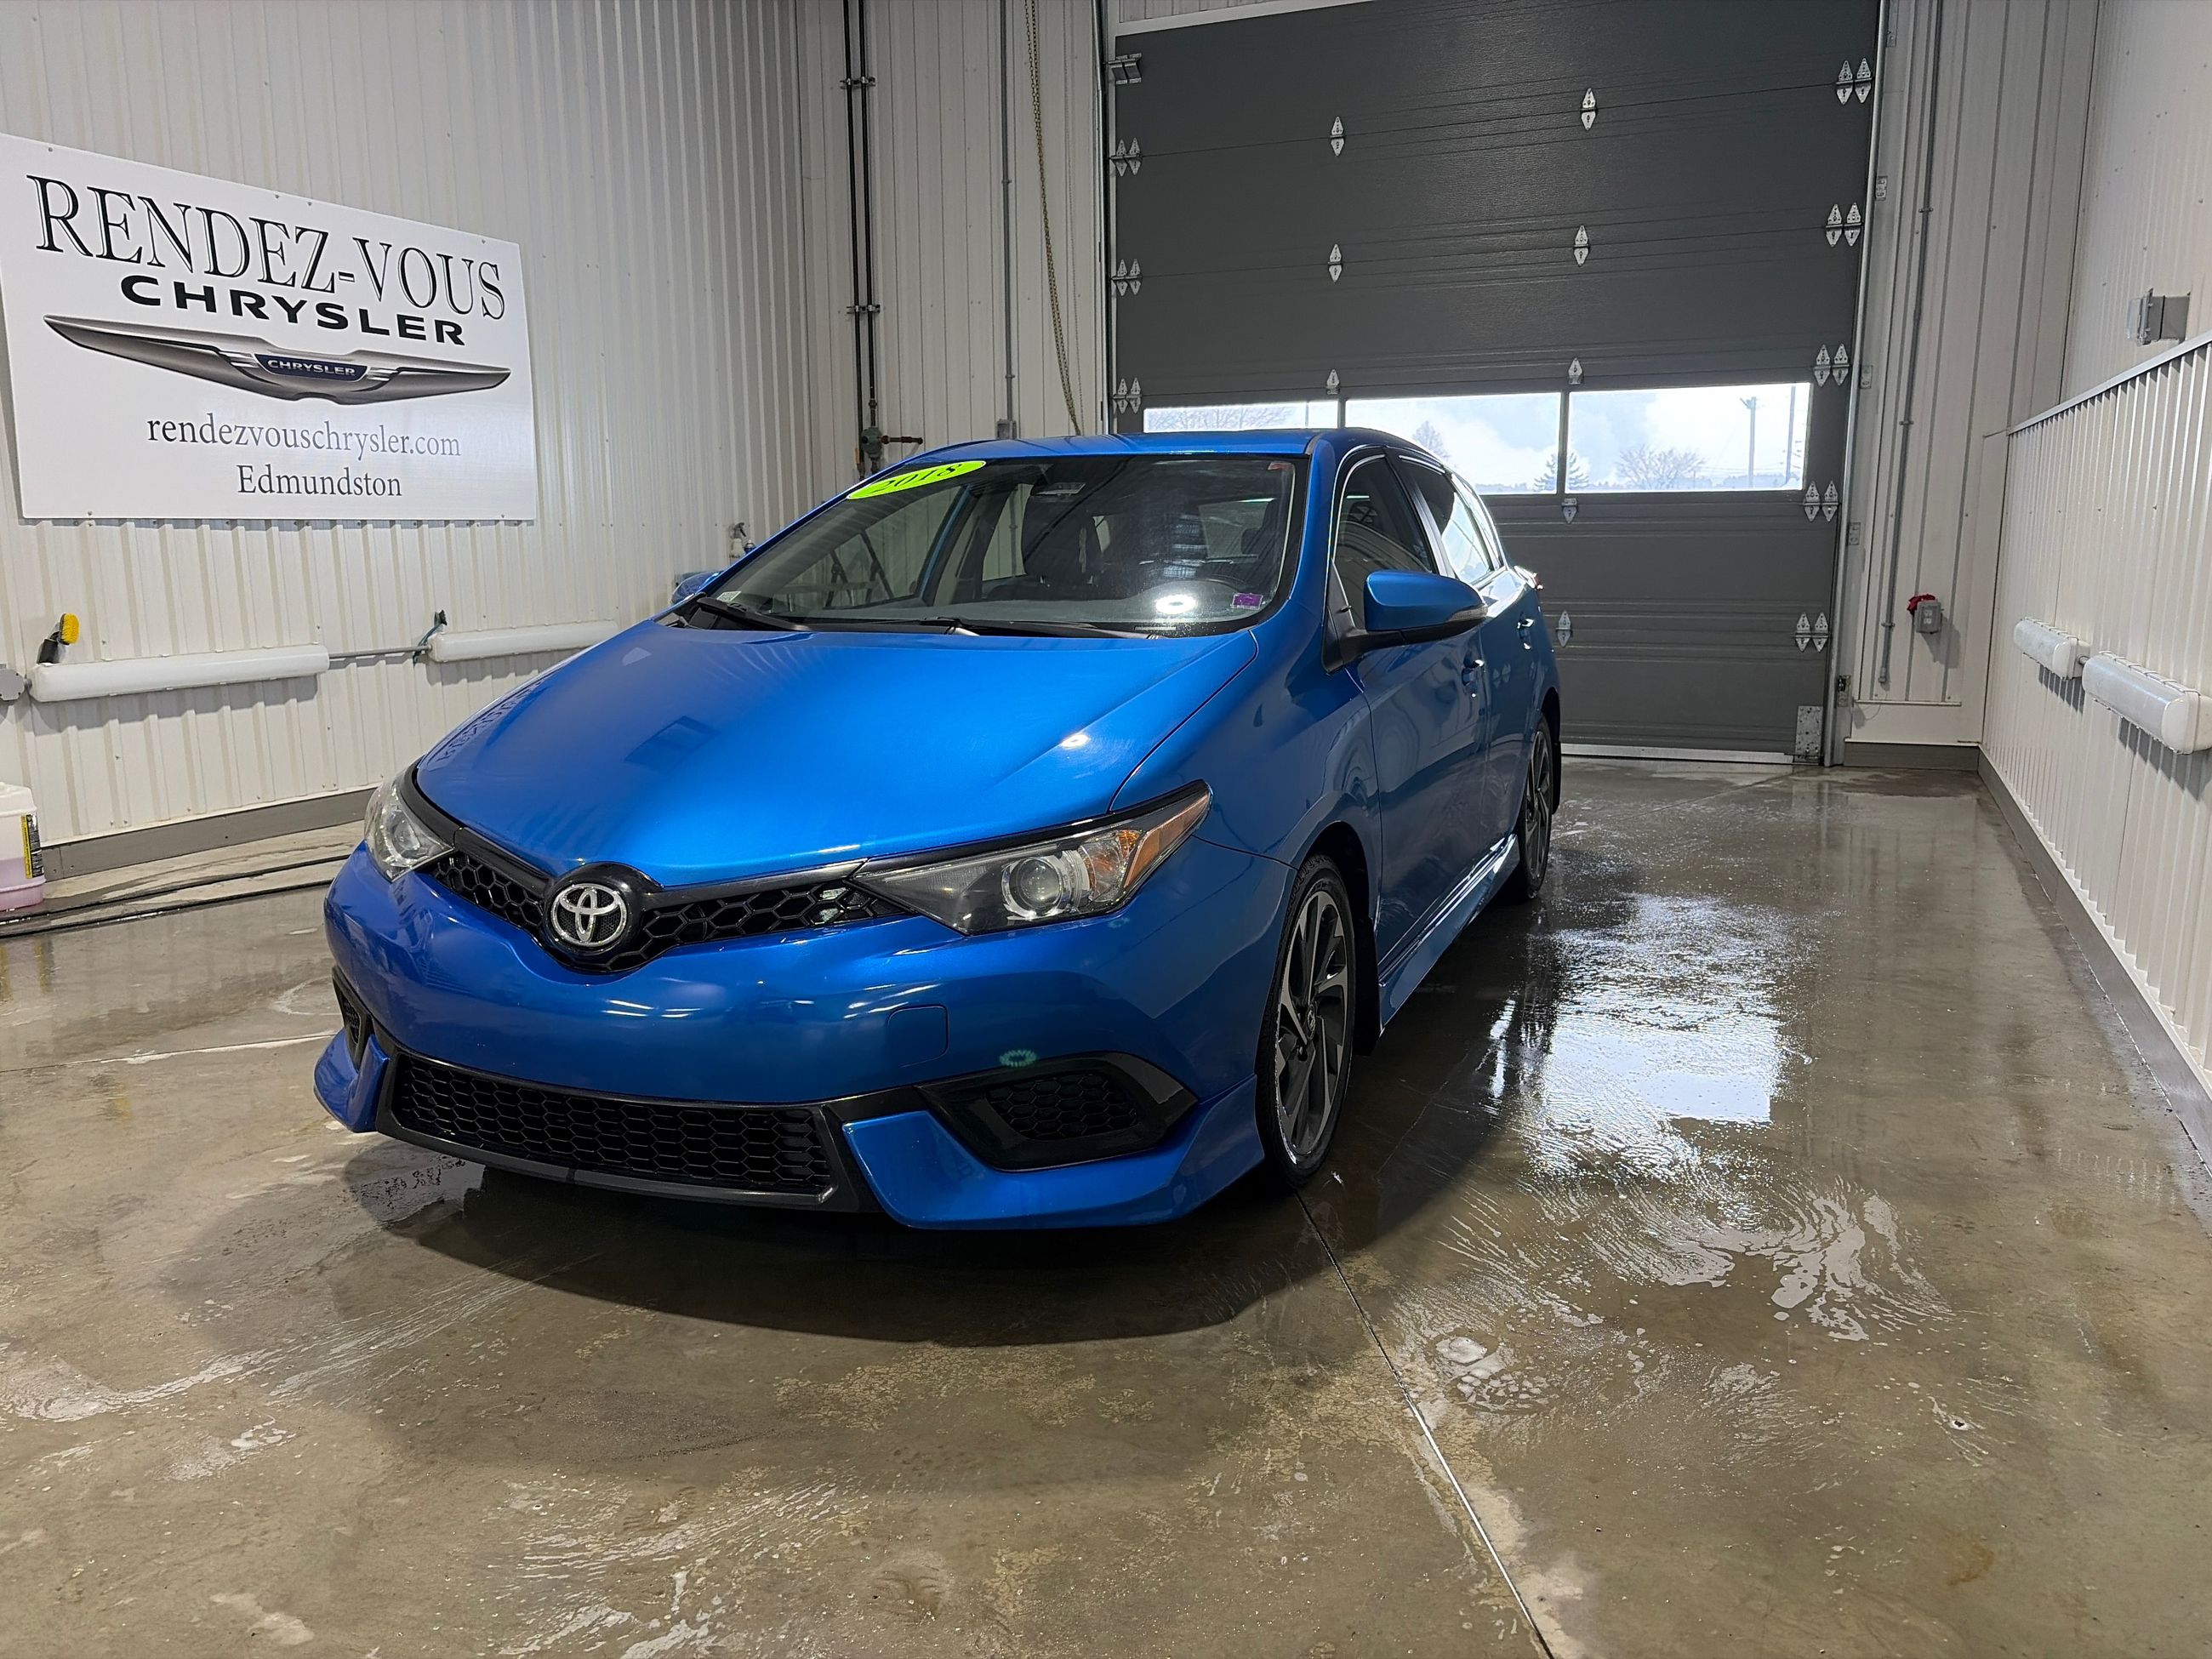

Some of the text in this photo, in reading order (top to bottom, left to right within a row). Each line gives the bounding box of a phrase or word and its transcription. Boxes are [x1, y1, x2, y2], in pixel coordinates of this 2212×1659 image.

[26, 174, 505, 321] RENDEZ-VOUS
[121, 274, 466, 346] CHRYSLER
[267, 359, 356, 376] CHRYSLER
[147, 413, 462, 461] rendezvouschrysler.com
[237, 465, 402, 498] Edmundston
[868, 463, 962, 494] 2018
